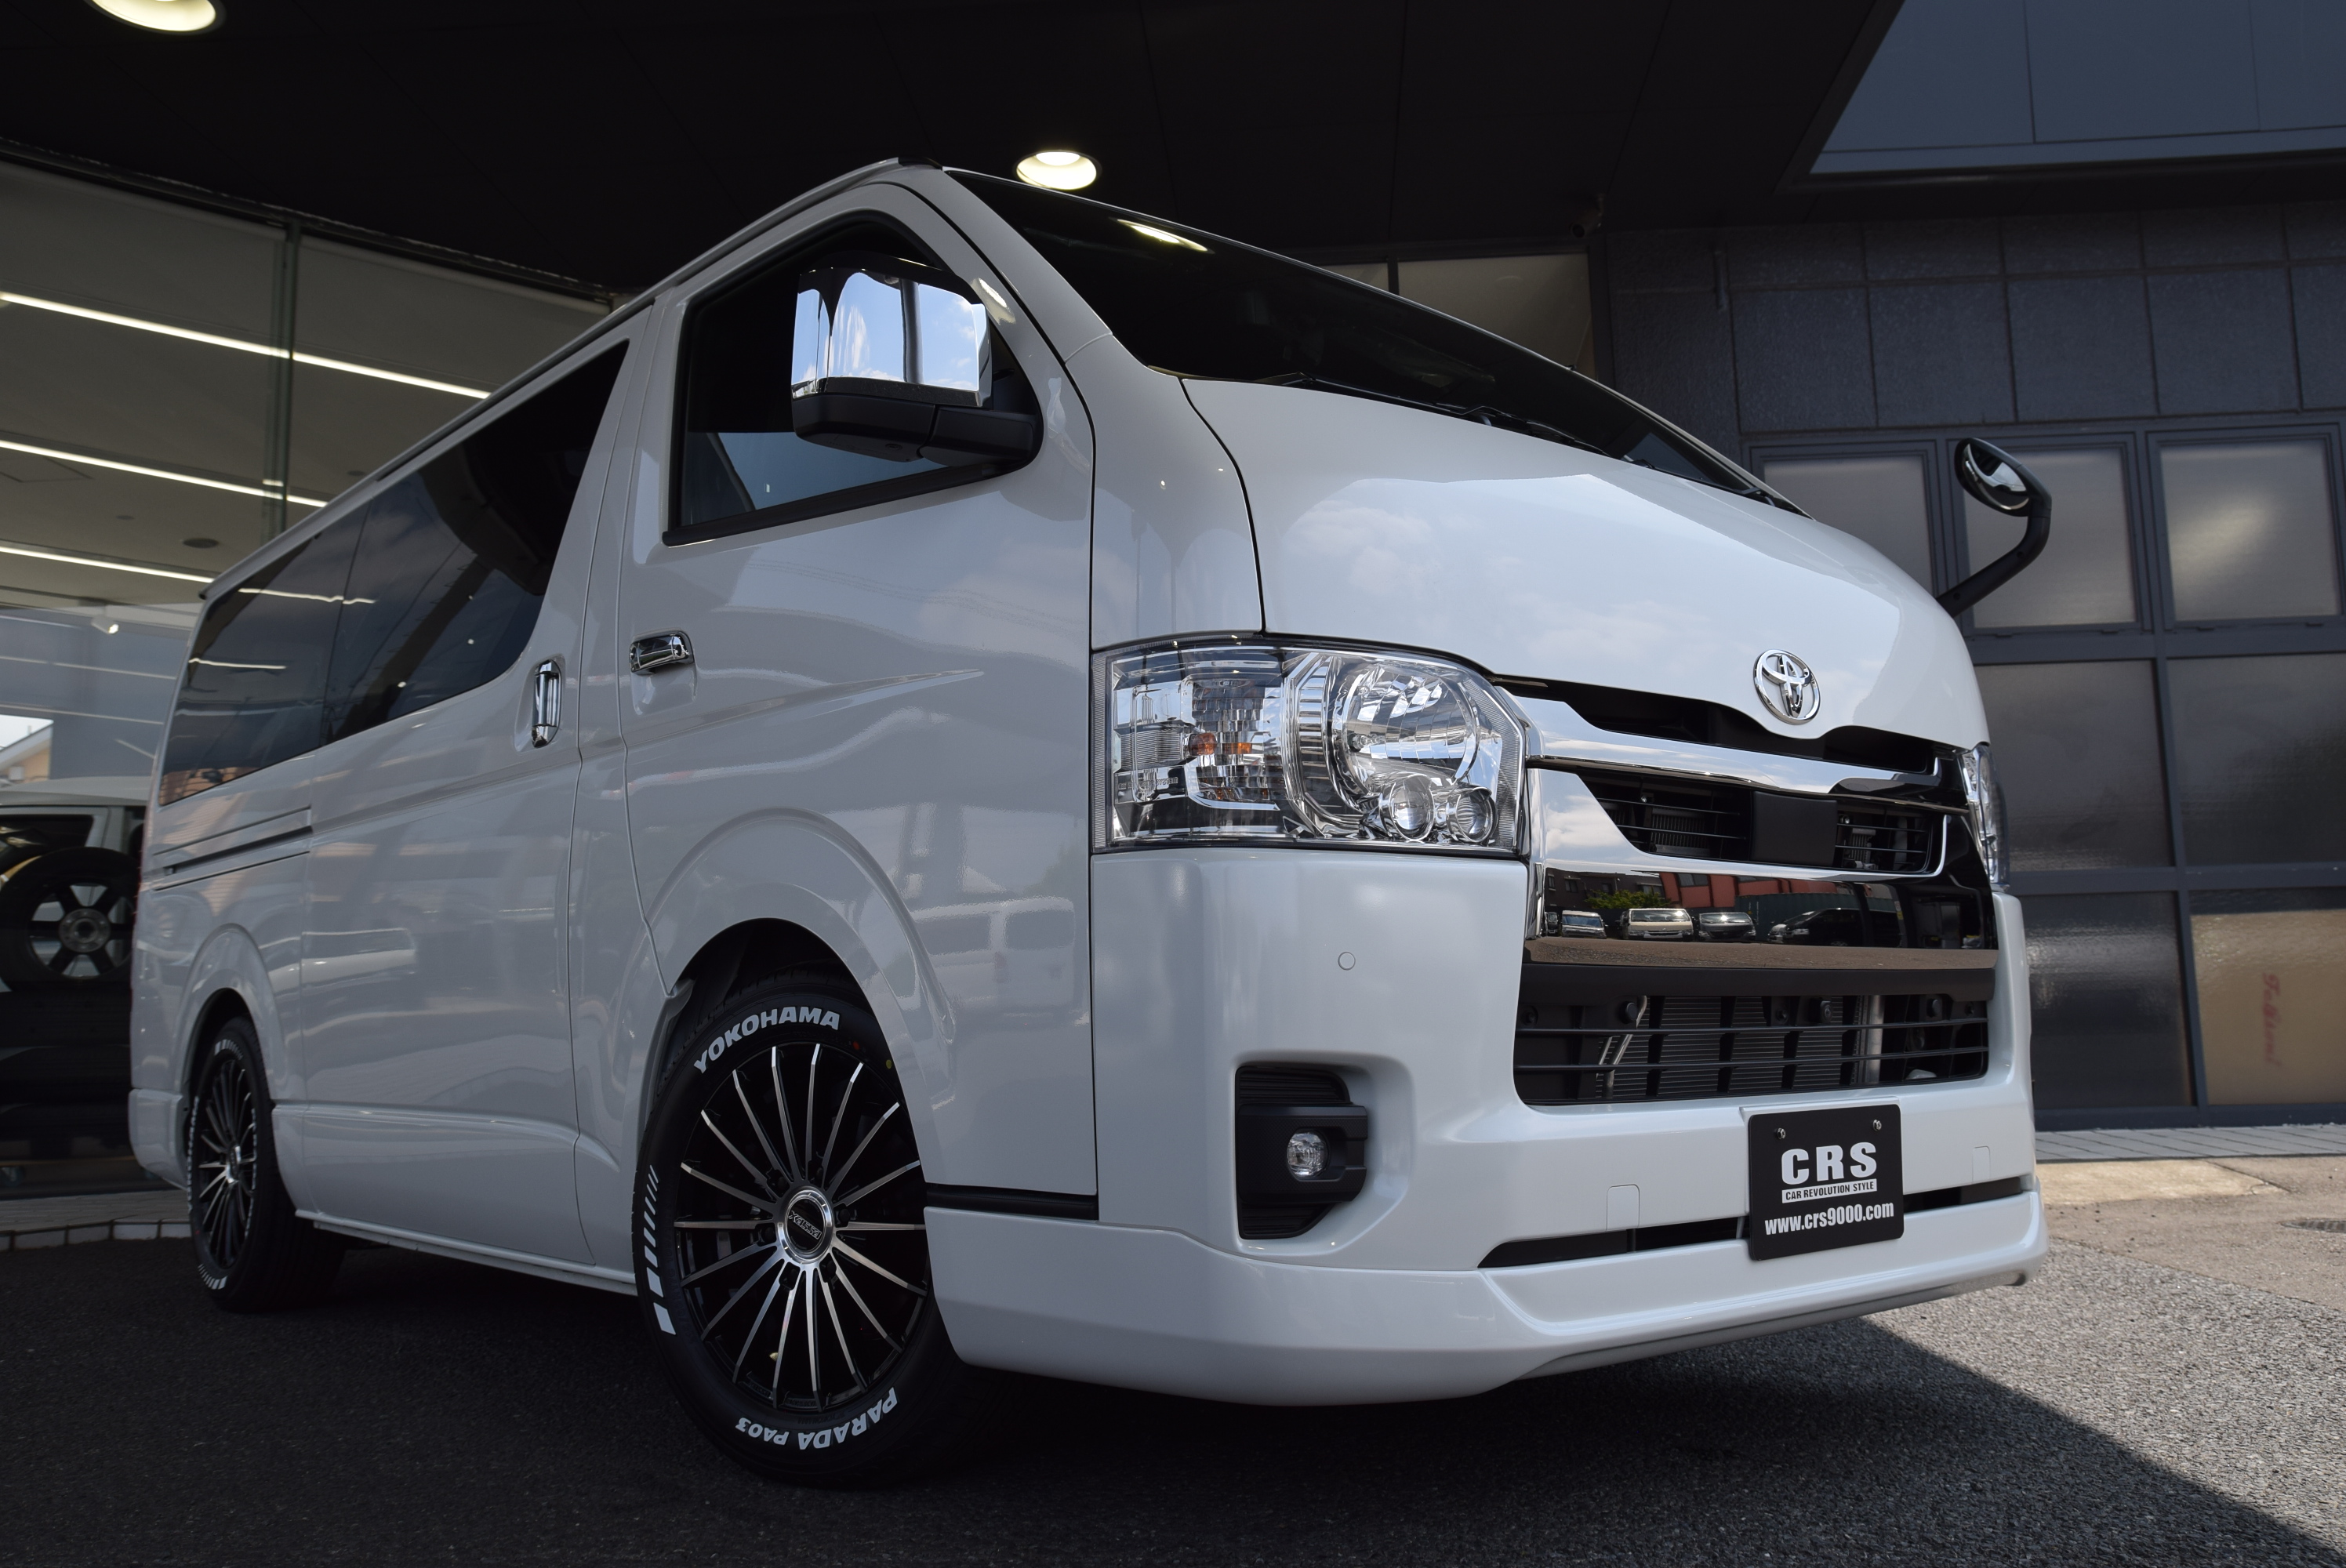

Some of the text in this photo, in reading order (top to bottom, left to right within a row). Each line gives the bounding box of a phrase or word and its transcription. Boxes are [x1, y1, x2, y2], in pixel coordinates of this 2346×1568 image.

[694, 1007, 841, 1074] YOKOHAMA
[1781, 1142, 1877, 1185] CRS
[1785, 1181, 1875, 1200] CAR REVOLUTION STYLE
[1764, 1202, 1894, 1236] www.crs9000.com
[735, 1387, 898, 1450] PARADA PA03
